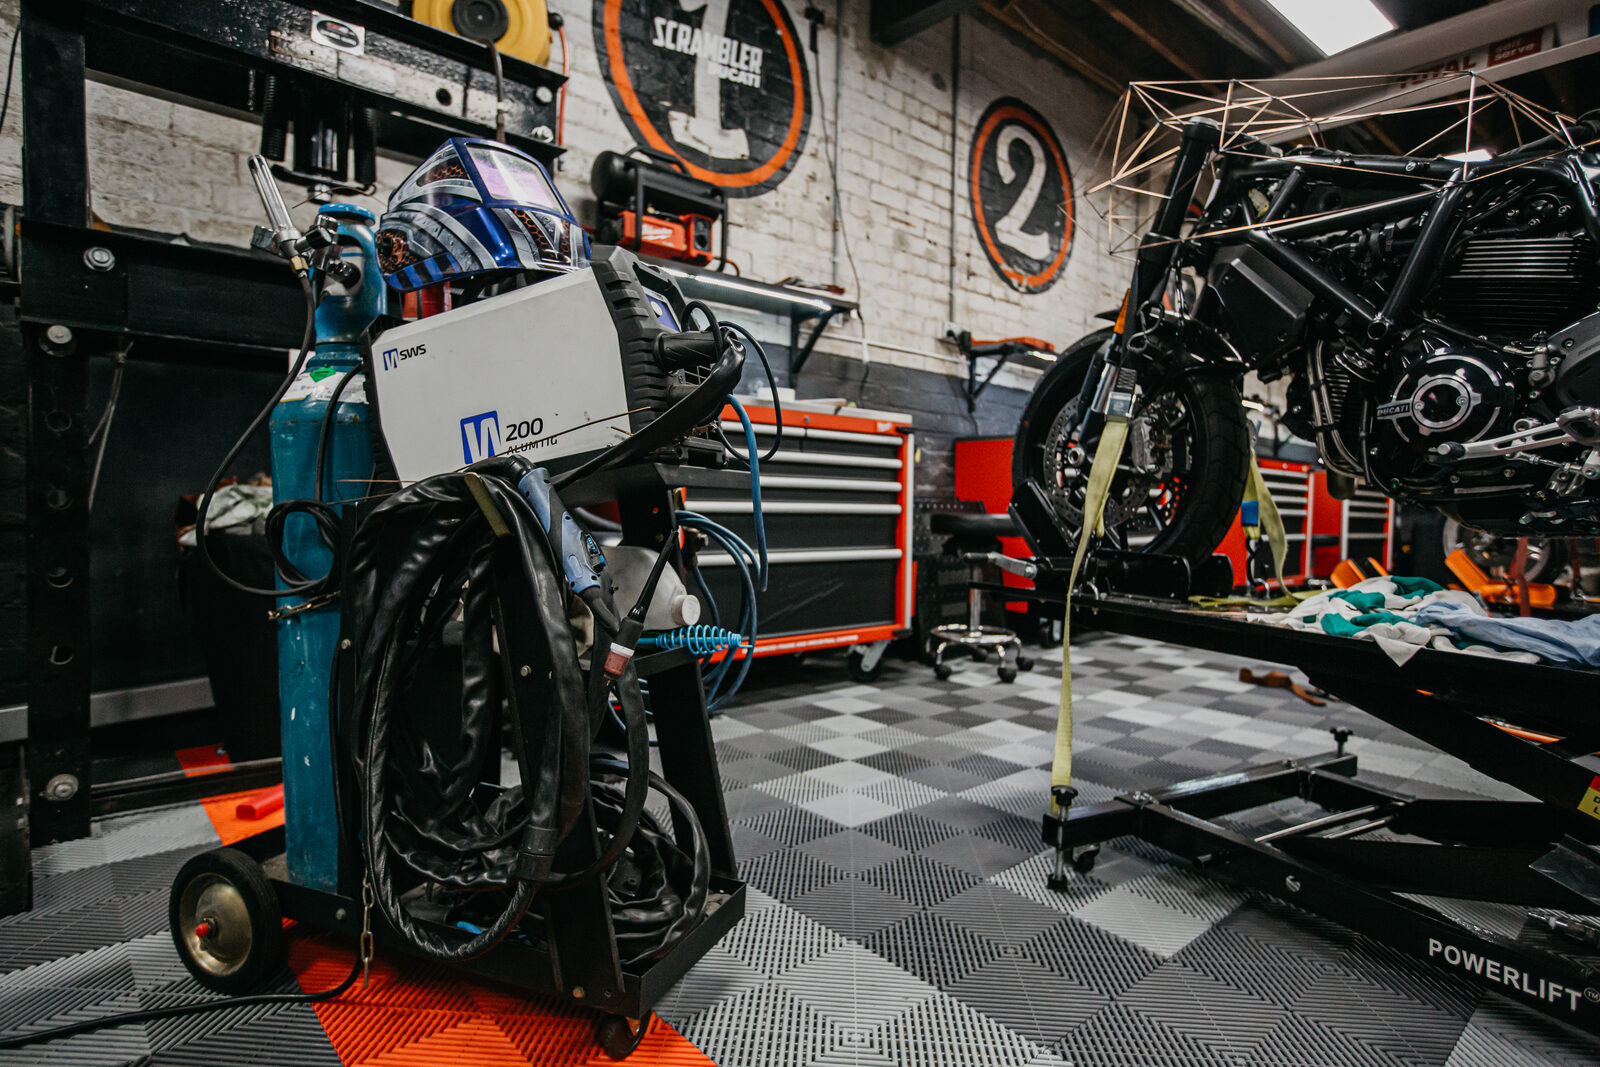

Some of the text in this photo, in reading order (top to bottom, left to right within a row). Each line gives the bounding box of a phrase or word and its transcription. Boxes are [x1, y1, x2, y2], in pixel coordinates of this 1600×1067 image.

[652, 16, 763, 74] SCRAMBLER
[995, 124, 1051, 260] 2
[399, 344, 427, 361] SWS
[505, 417, 544, 442] 200
[1377, 404, 1410, 417] DUCATI
[1428, 937, 1582, 1011] POWERLIFT
